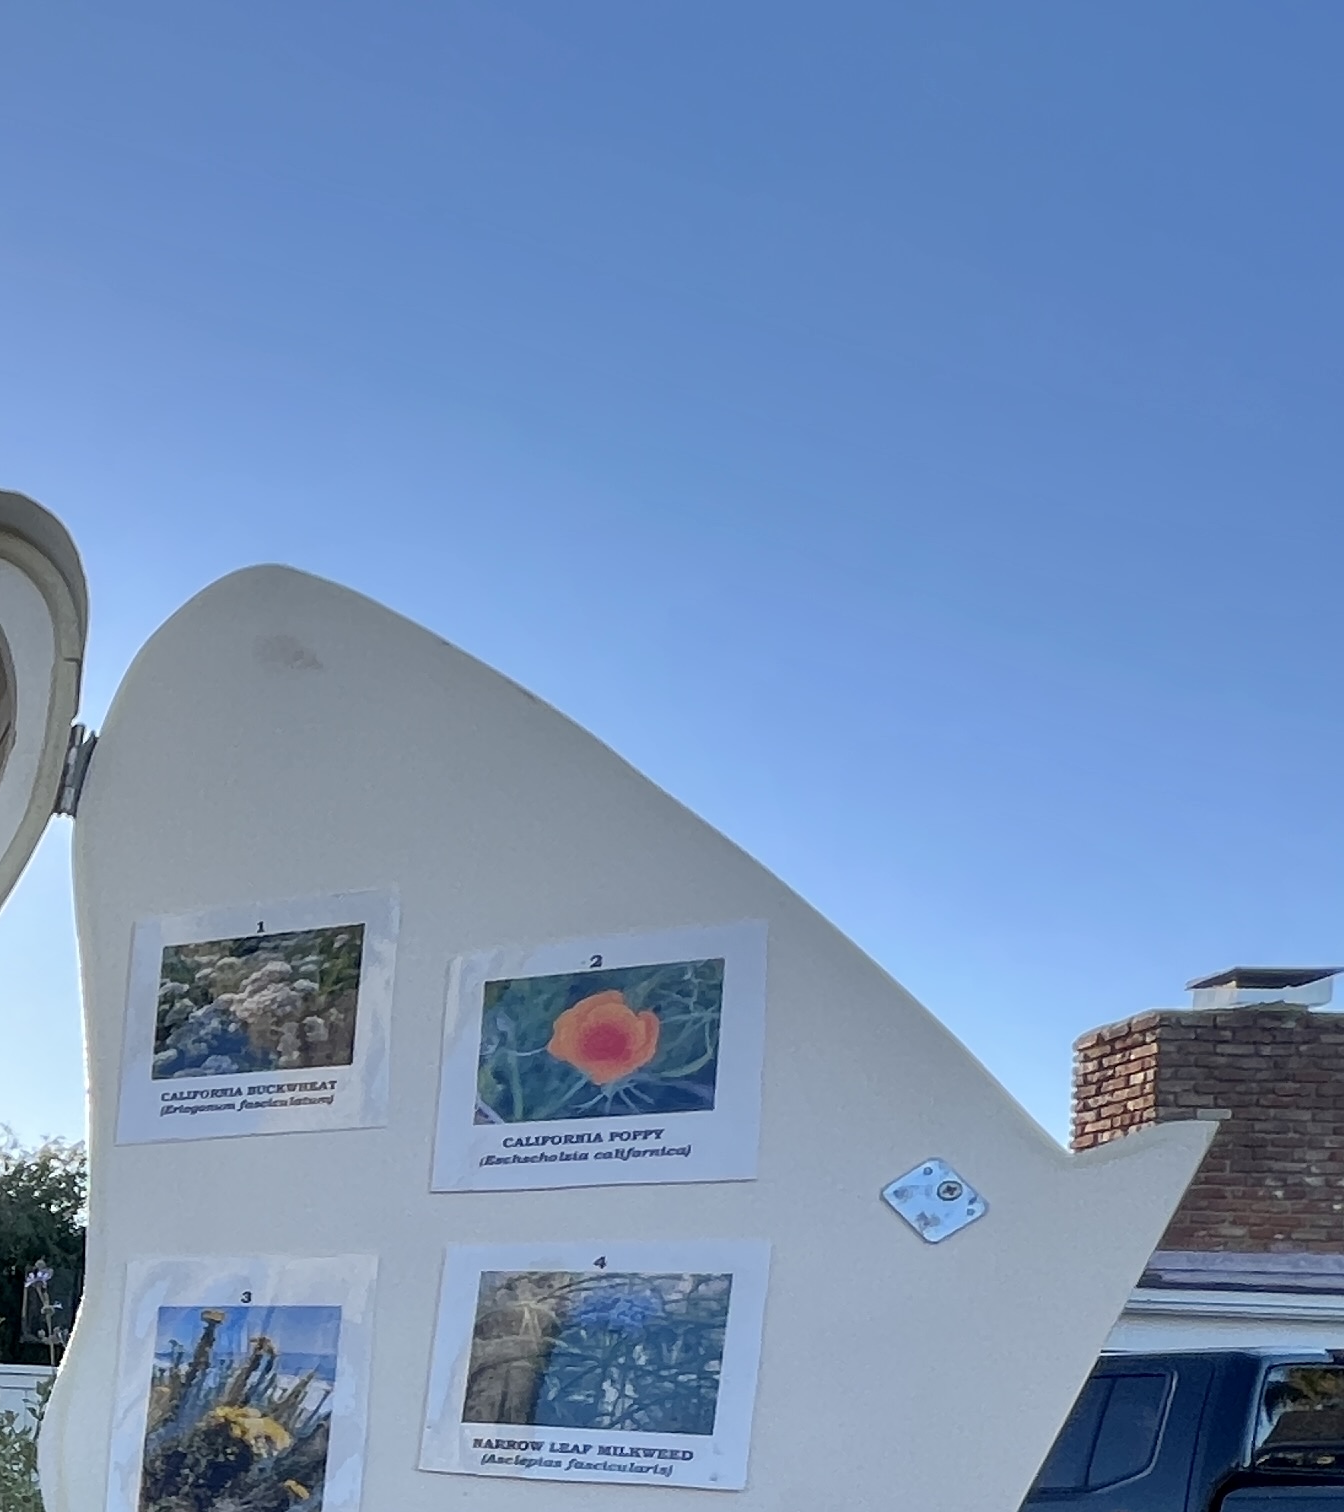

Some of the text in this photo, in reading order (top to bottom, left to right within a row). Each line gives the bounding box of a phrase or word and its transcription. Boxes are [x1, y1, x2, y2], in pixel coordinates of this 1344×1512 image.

[257, 921, 265, 933] 1
[590, 954, 603, 968] 2
[161, 1081, 337, 1101] CALIFORNIA BUCKWHEAT
[503, 1128, 665, 1148] CALIFORNIA POPPY
[593, 1256, 607, 1269] 4
[241, 1291, 252, 1303] 3
[473, 1438, 694, 1461] NARROW LEAF MILKWEED
